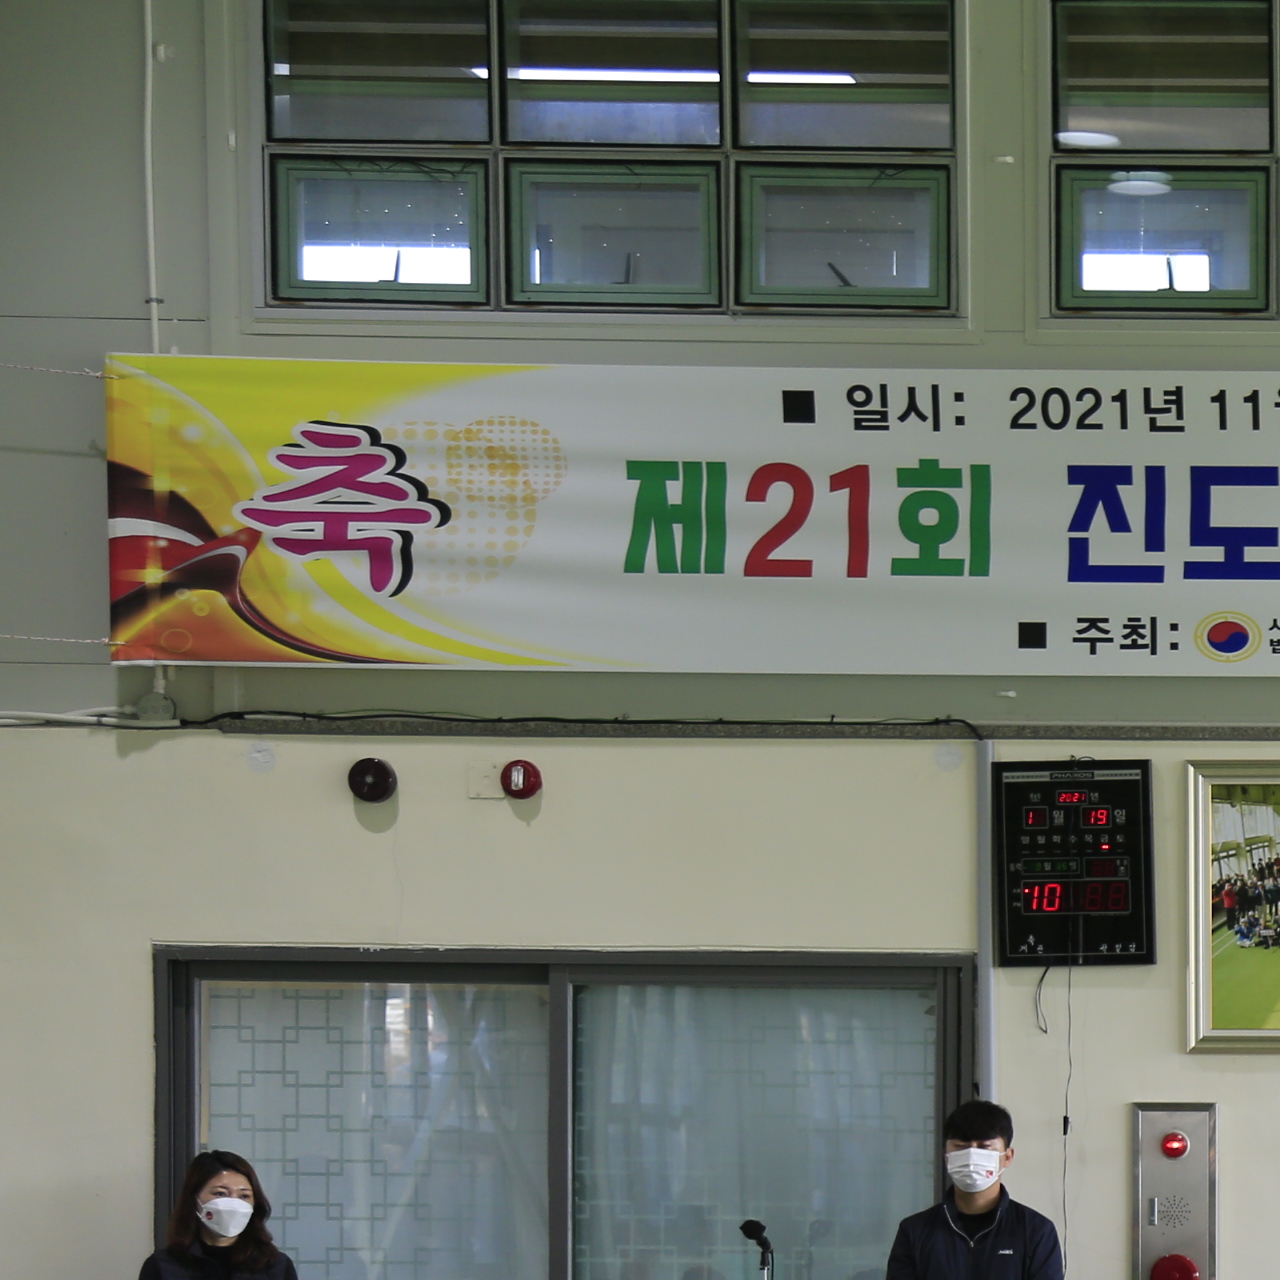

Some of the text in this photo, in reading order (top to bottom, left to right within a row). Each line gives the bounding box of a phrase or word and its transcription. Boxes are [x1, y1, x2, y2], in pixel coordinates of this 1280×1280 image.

[846, 383, 966, 432] 일시:
[1009, 385, 1186, 433] 2021년
[232, 420, 452, 598] 축
[624, 458, 991, 579] 제21회
[1072, 615, 1180, 655] 주최:
